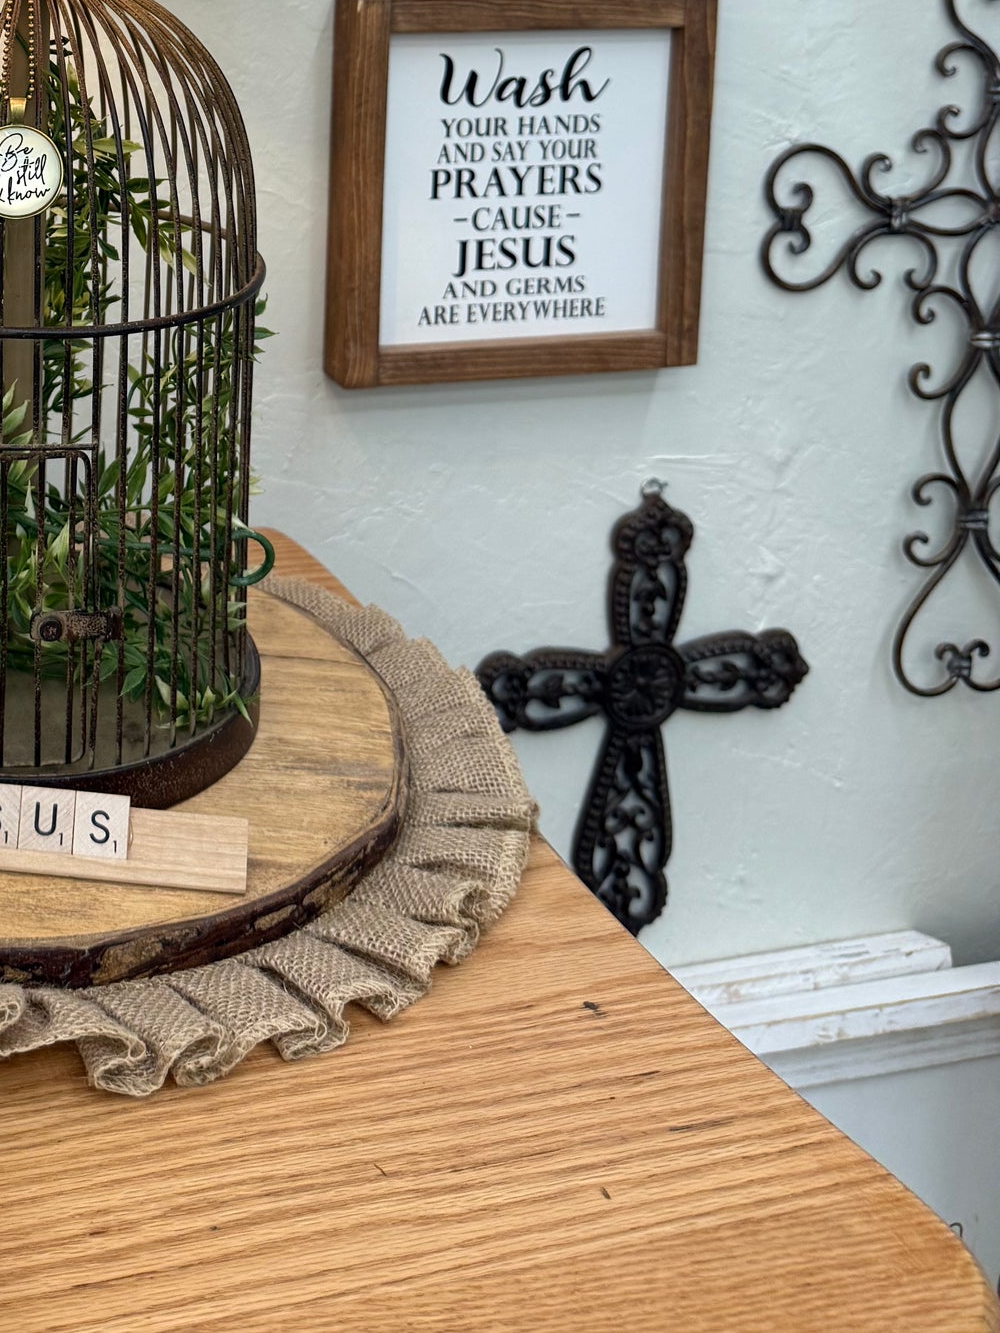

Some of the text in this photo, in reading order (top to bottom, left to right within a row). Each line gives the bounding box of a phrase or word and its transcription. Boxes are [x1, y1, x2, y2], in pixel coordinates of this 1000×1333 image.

[439, 46, 610, 108] Wash
[441, 114, 600, 138] YOUR HANDS
[437, 139, 597, 164] AND SAY YOUR
[17, 154, 46, 186] still
[429, 163, 602, 200] PRAYERS
[452, 235, 575, 277] JESUS
[443, 275, 585, 299] AND GERMS
[418, 297, 605, 326] ARE EVERYWHERE
